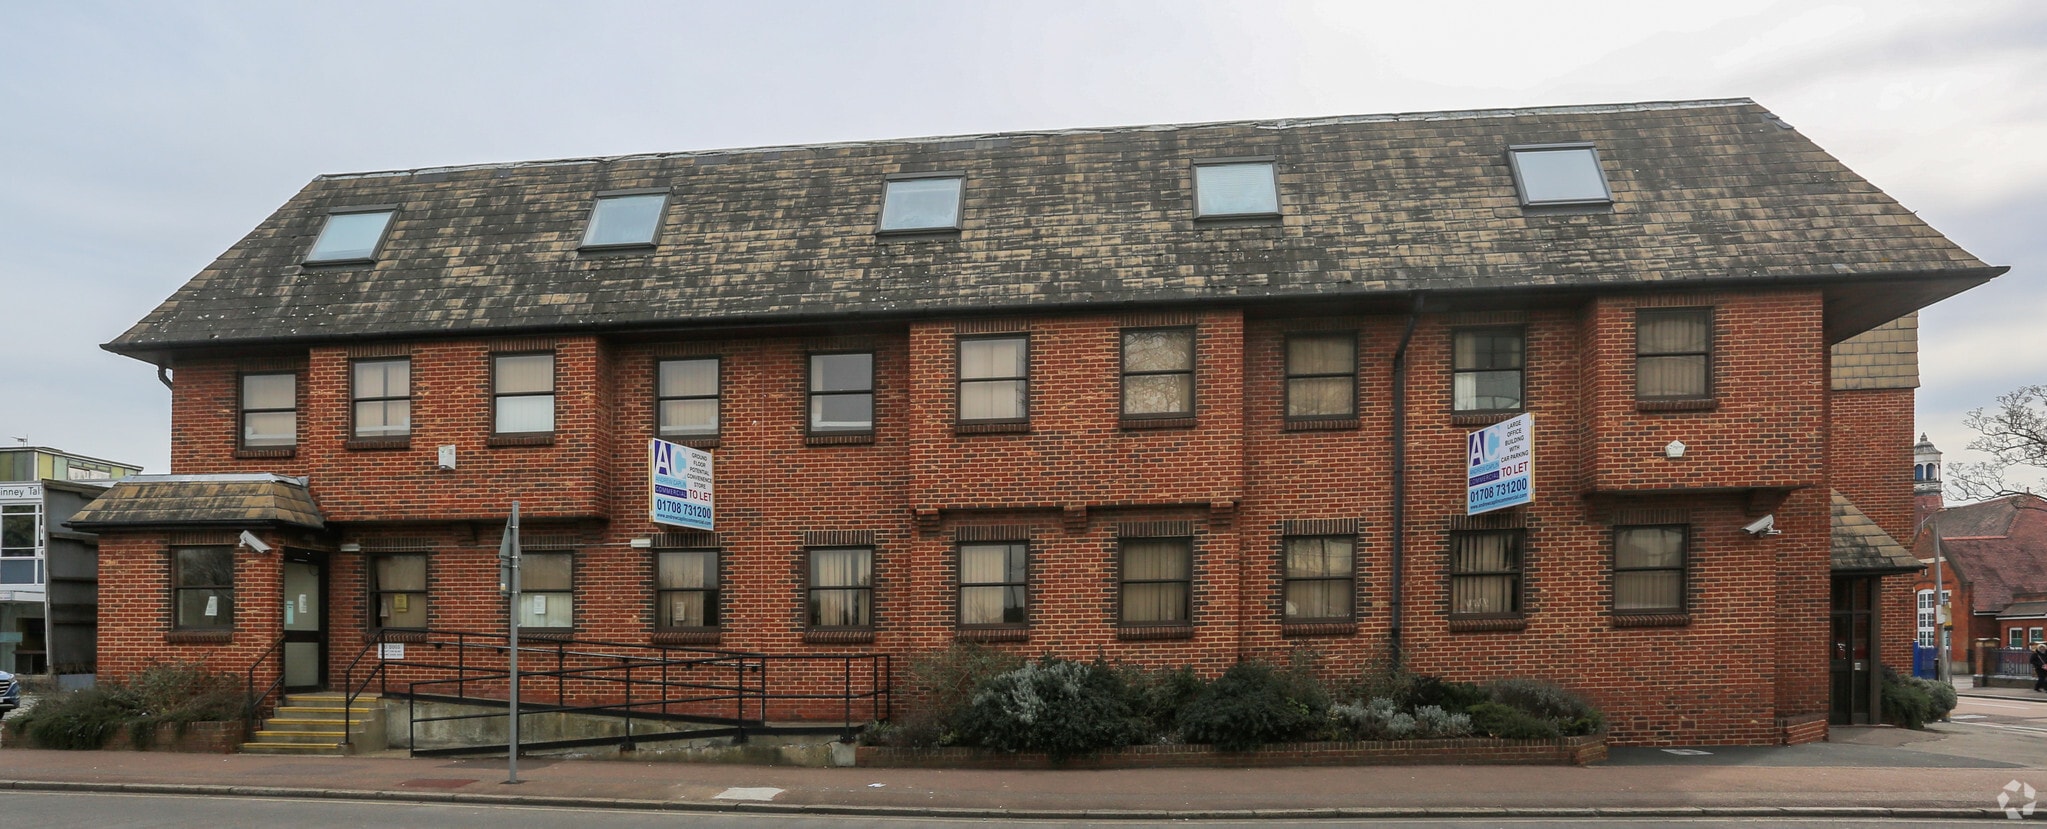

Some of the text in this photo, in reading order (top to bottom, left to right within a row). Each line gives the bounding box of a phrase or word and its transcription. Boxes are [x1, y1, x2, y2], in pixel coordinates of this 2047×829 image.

[1507, 420, 1521, 429] LARGE
[1507, 428, 1522, 437] OFFICE
[1505, 435, 1525, 446] BUILDING
[1509, 444, 1520, 453] WITH
[691, 452, 707, 461] GROUND
[1501, 450, 1529, 463] CAR PARKING
[1501, 461, 1528, 478] TO LET
[655, 485, 687, 498] COMMERCIAL
[689, 489, 711, 502] TO LET
[1470, 478, 1527, 503] 01708 731200
[657, 499, 711, 519] 01708 731200
